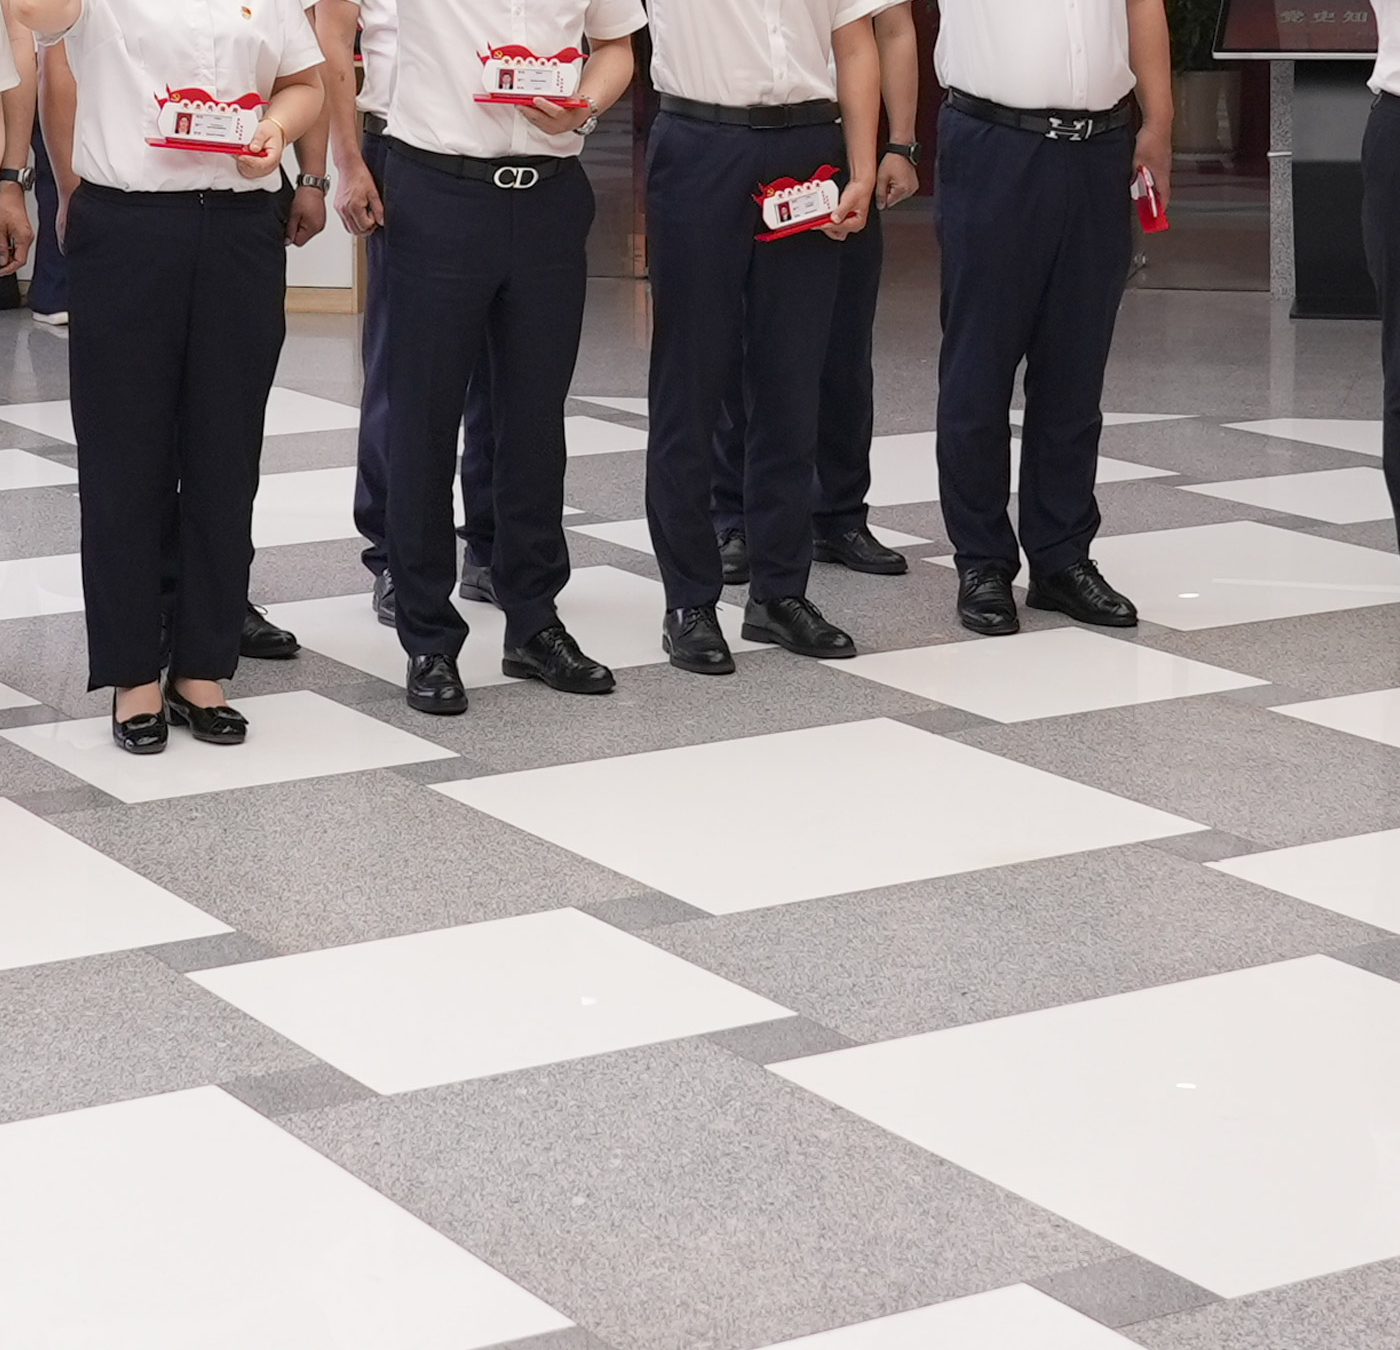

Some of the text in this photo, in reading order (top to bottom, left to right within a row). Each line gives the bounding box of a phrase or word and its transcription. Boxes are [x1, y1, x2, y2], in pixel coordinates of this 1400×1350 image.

[1280, 9, 1368, 23] 党史知
[493, 166, 540, 189] CD
